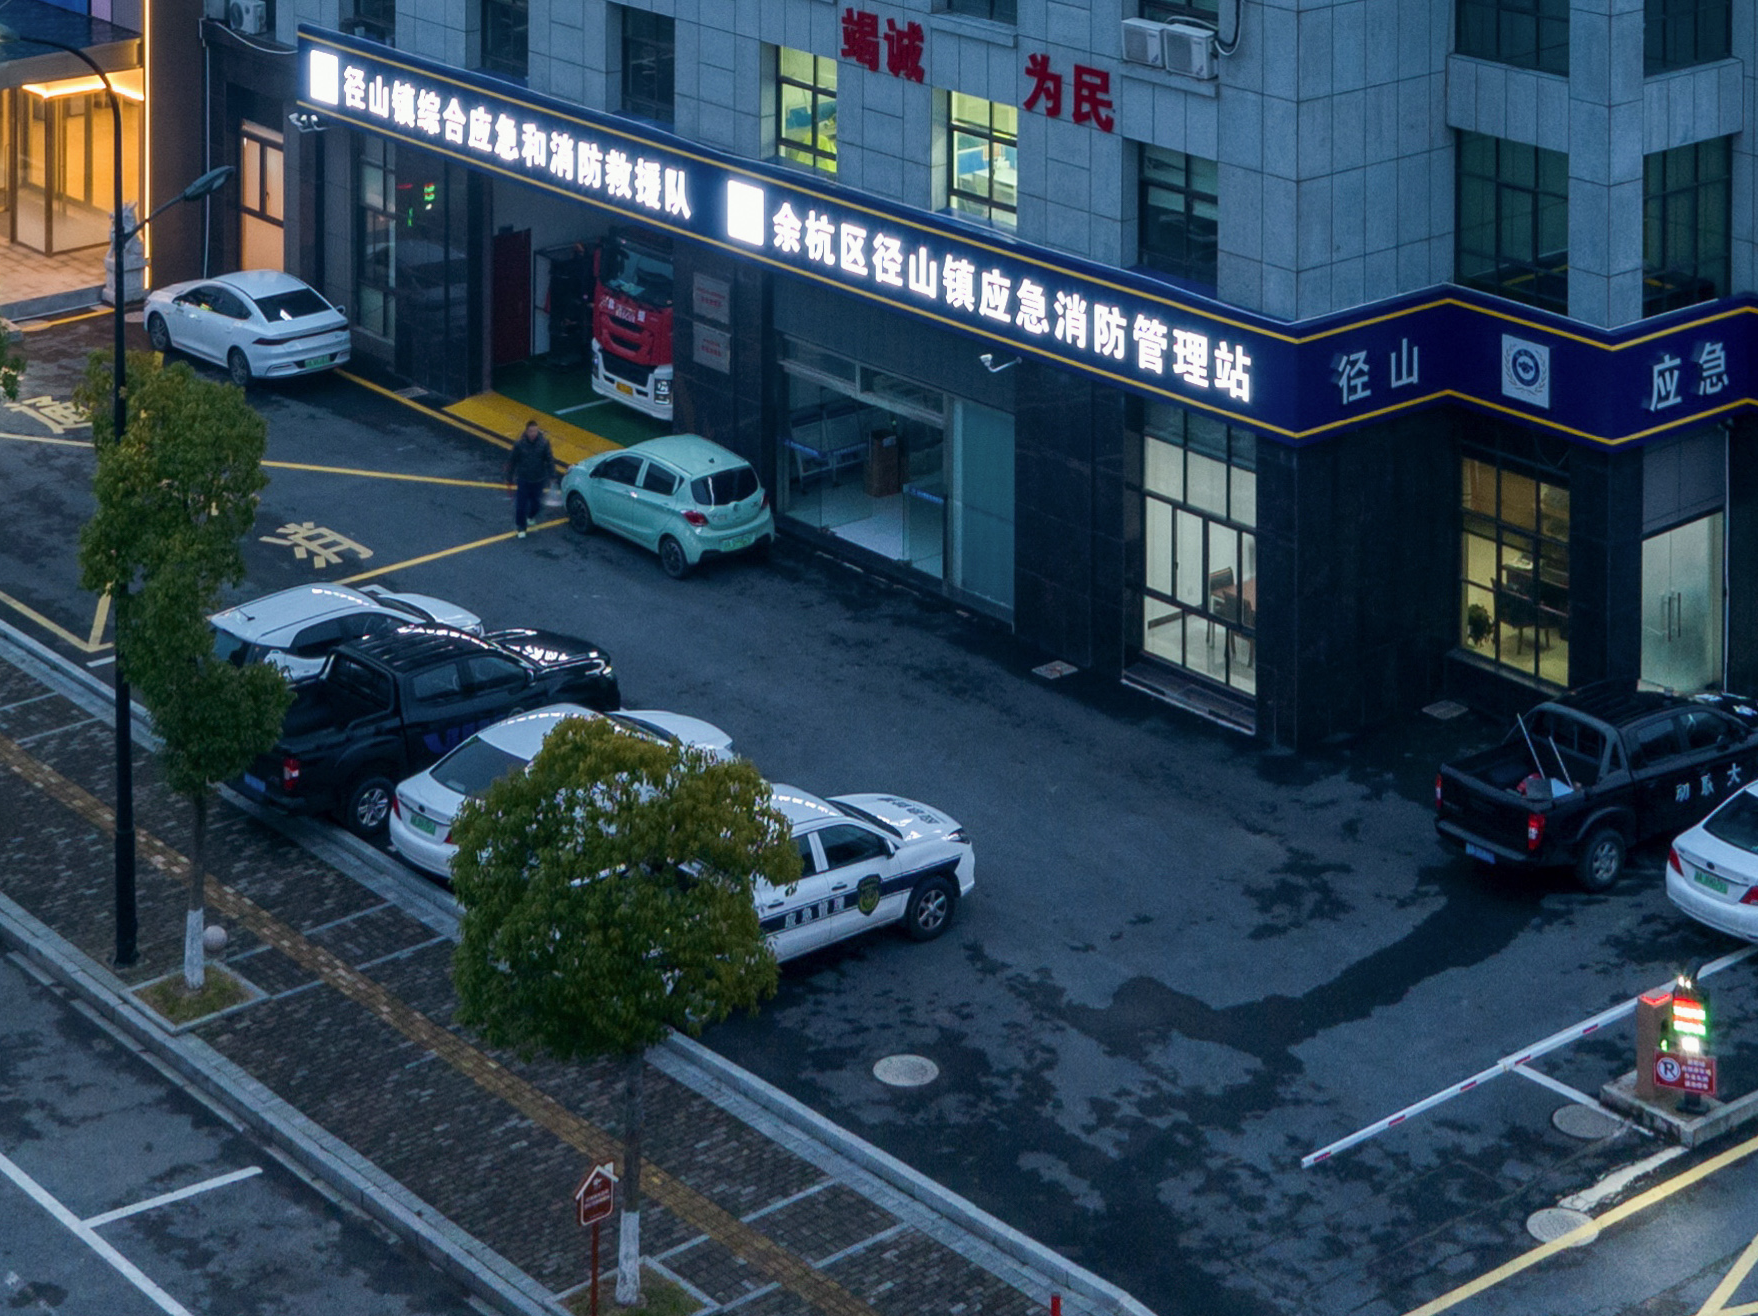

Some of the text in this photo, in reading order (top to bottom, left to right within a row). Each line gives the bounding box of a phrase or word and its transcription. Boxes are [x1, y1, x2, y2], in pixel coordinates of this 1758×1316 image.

[841, 9, 1113, 132] 竭诚 为民
[344, 65, 691, 220] 径山镇综合应急和消防救援队
[772, 201, 1251, 403] 余杭区径山镇应急消防管理站
[1336, 337, 1420, 405] 径山
[1649, 341, 1729, 412] 应急
